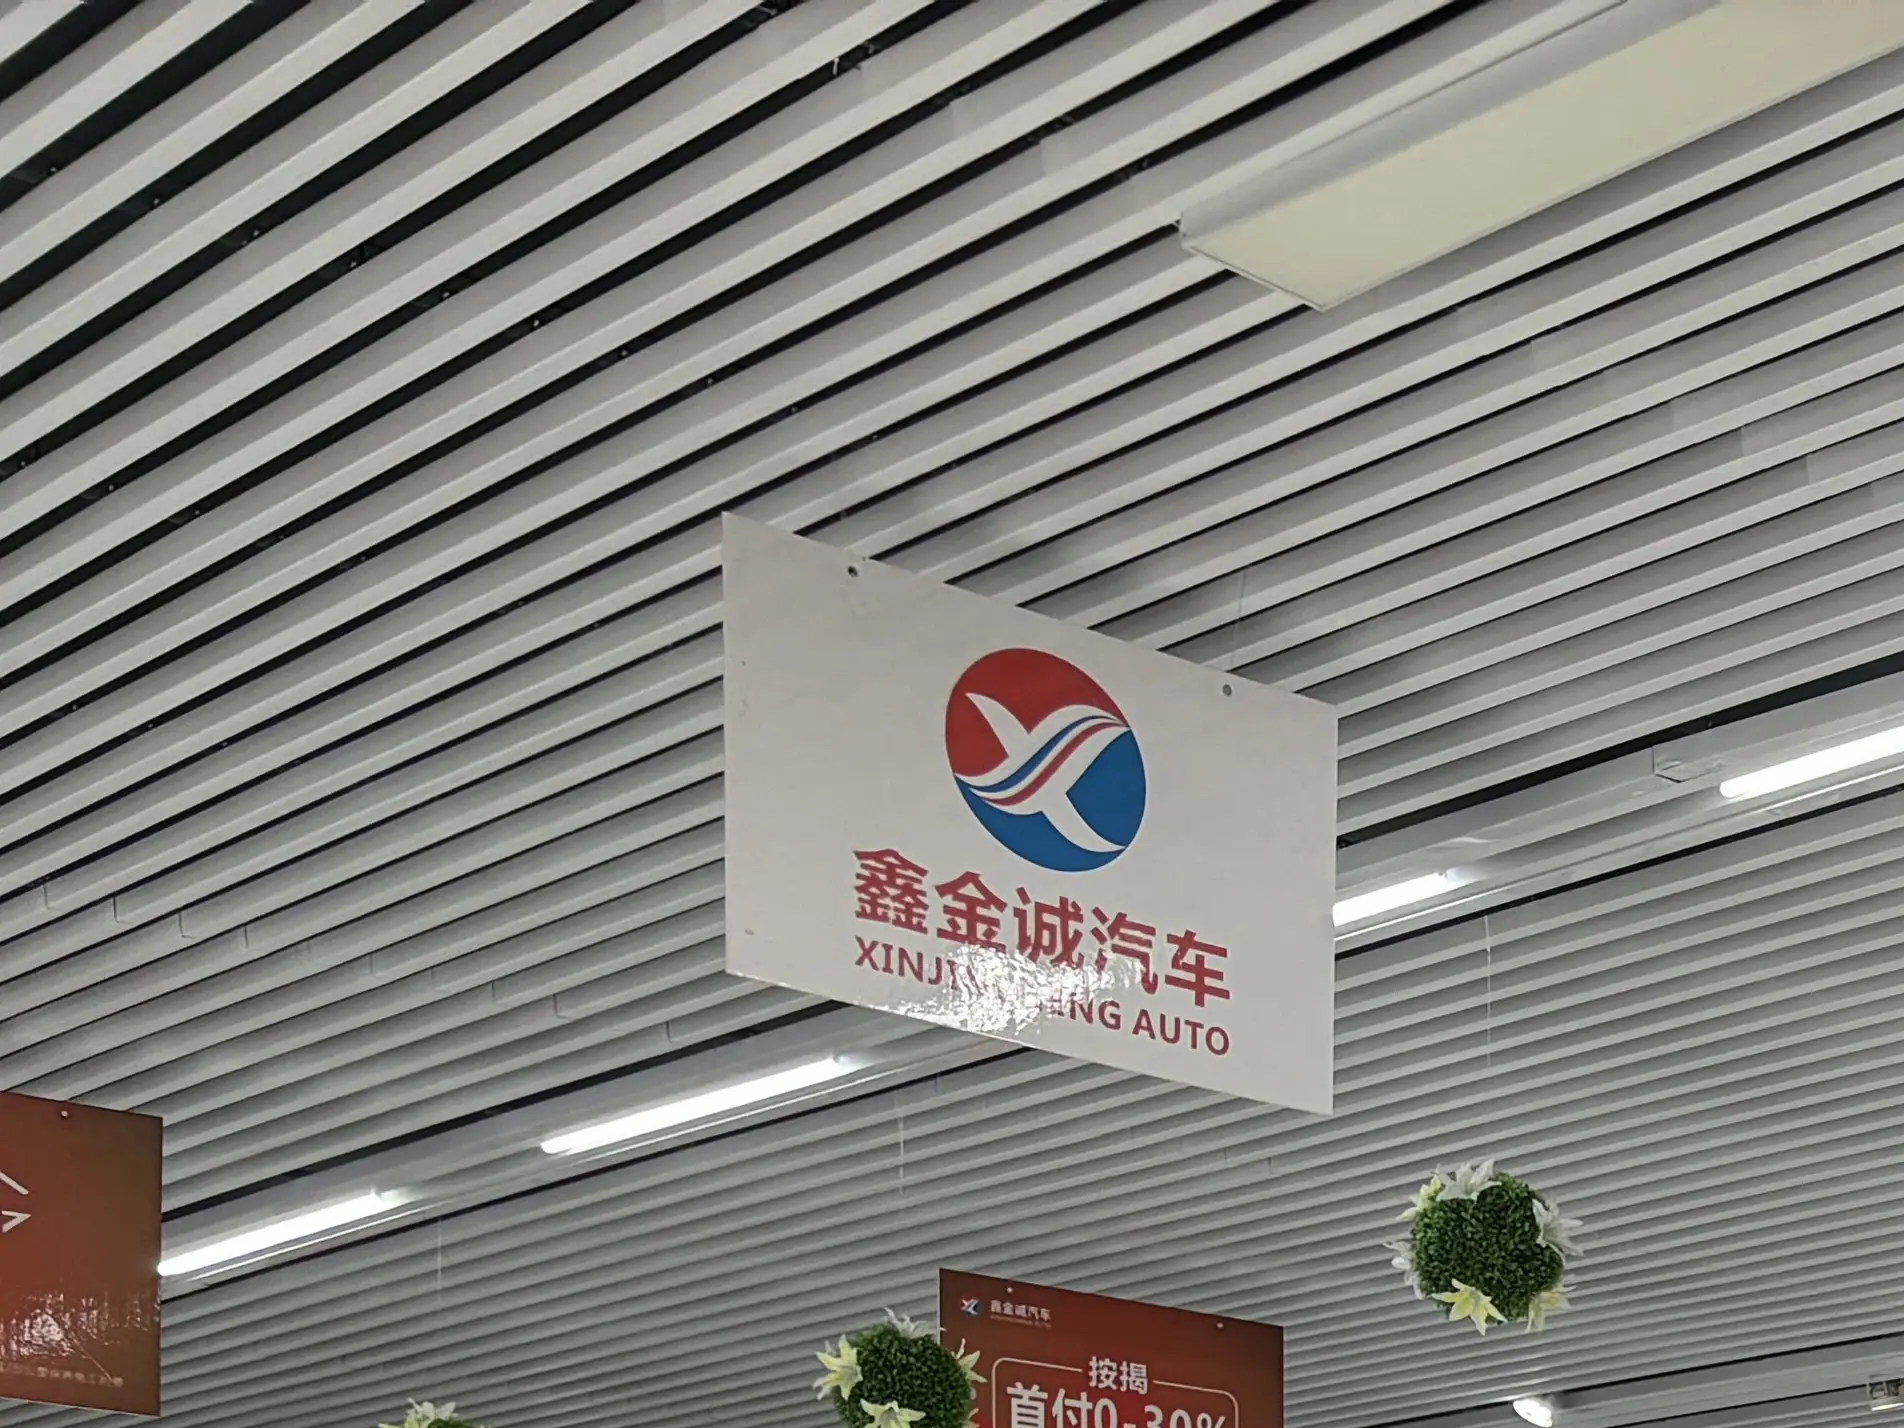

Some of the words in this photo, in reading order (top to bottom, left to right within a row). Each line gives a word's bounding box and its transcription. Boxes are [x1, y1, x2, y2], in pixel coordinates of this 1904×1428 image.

[852, 848, 1231, 1008] 鑫金诚汽车
[1131, 1008, 1231, 1056] AUTO
[1088, 1355, 1149, 1395] 按揭
